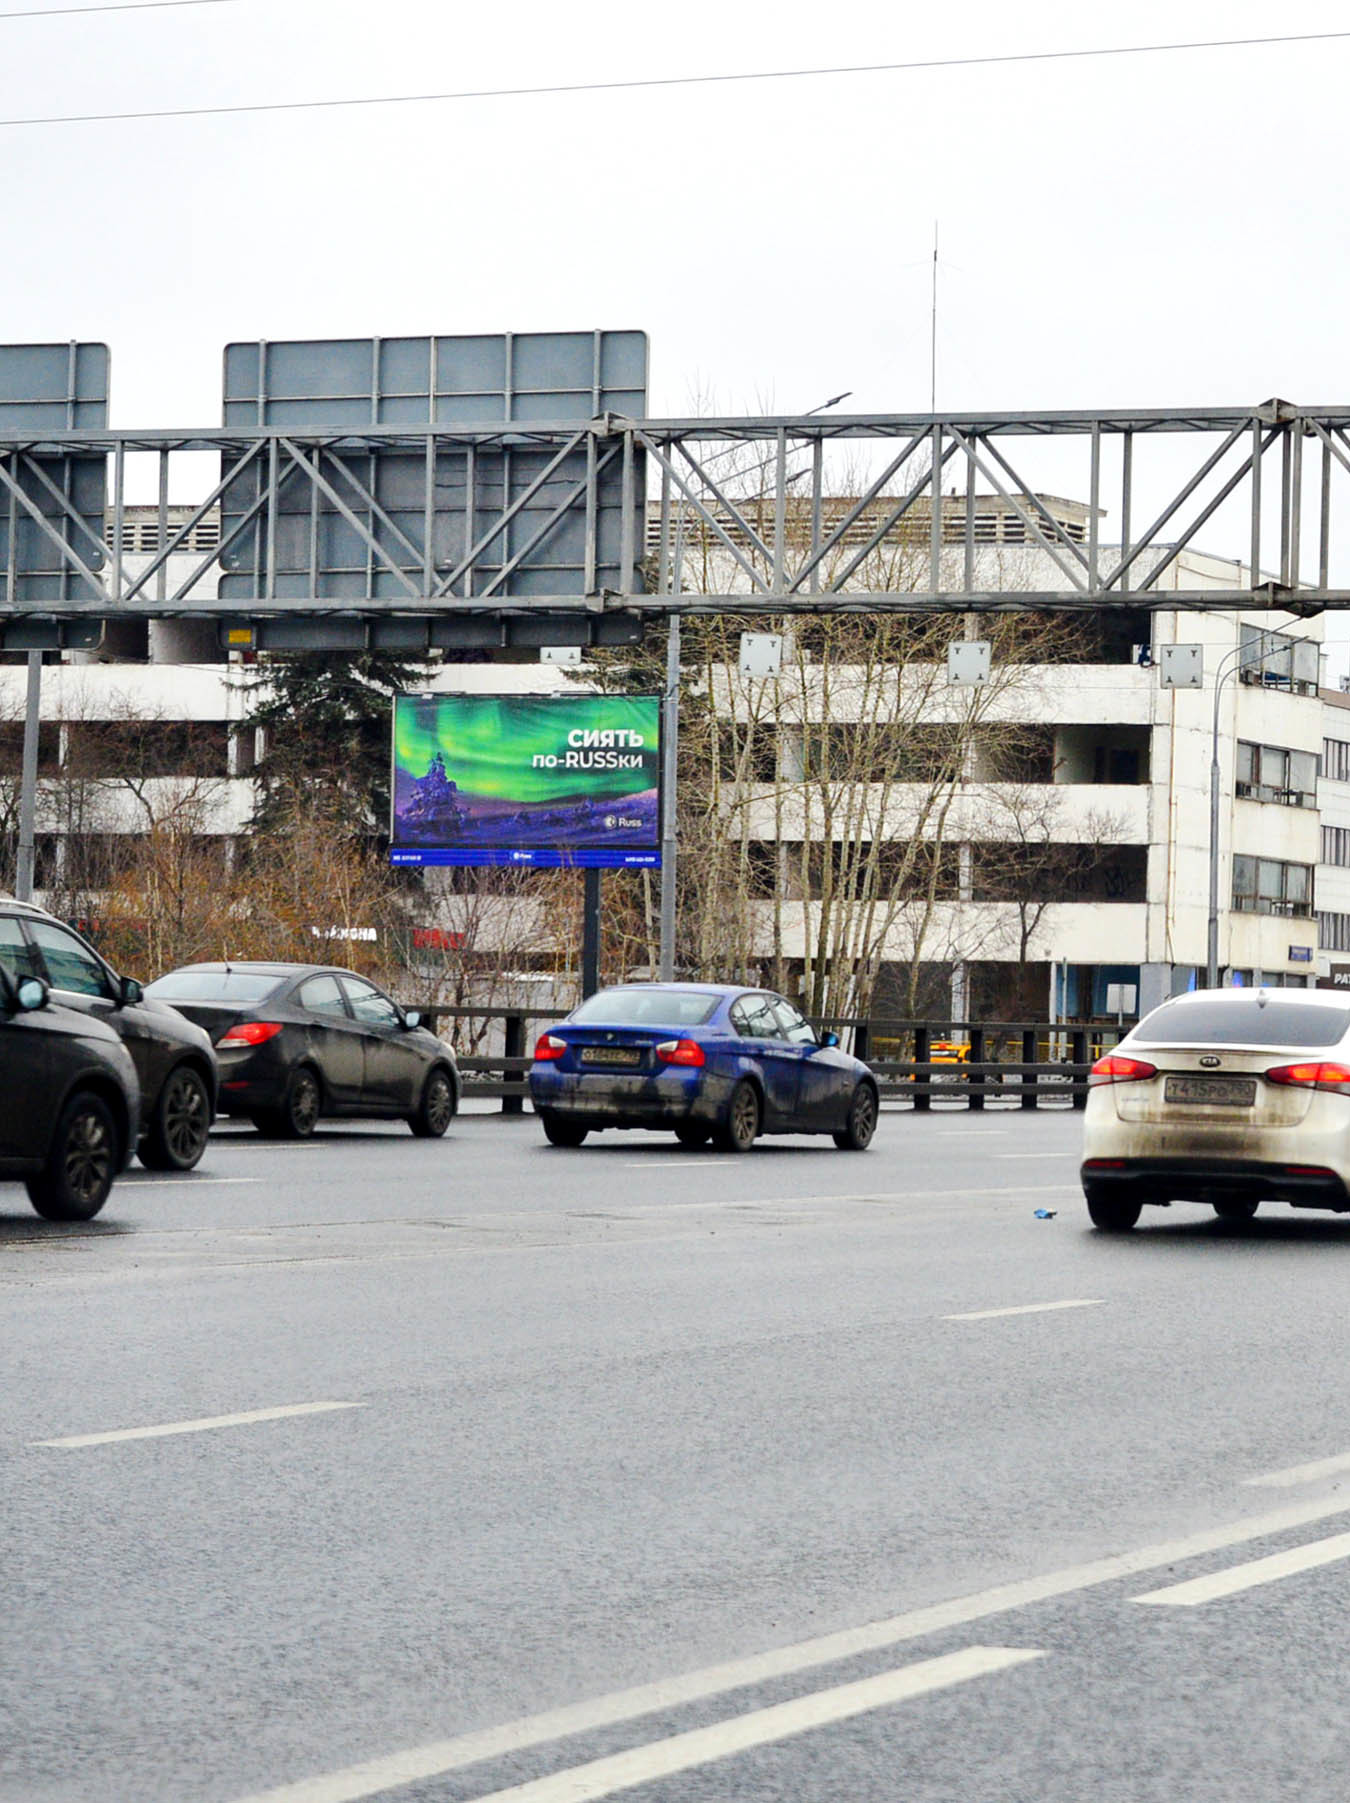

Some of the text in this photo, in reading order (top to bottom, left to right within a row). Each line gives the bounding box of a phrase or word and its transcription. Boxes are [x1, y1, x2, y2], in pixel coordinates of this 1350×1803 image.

[568, 729, 644, 748] СИЯТЬ
[532, 751, 643, 768] по-RUSSки
[618, 817, 642, 827] Russ
